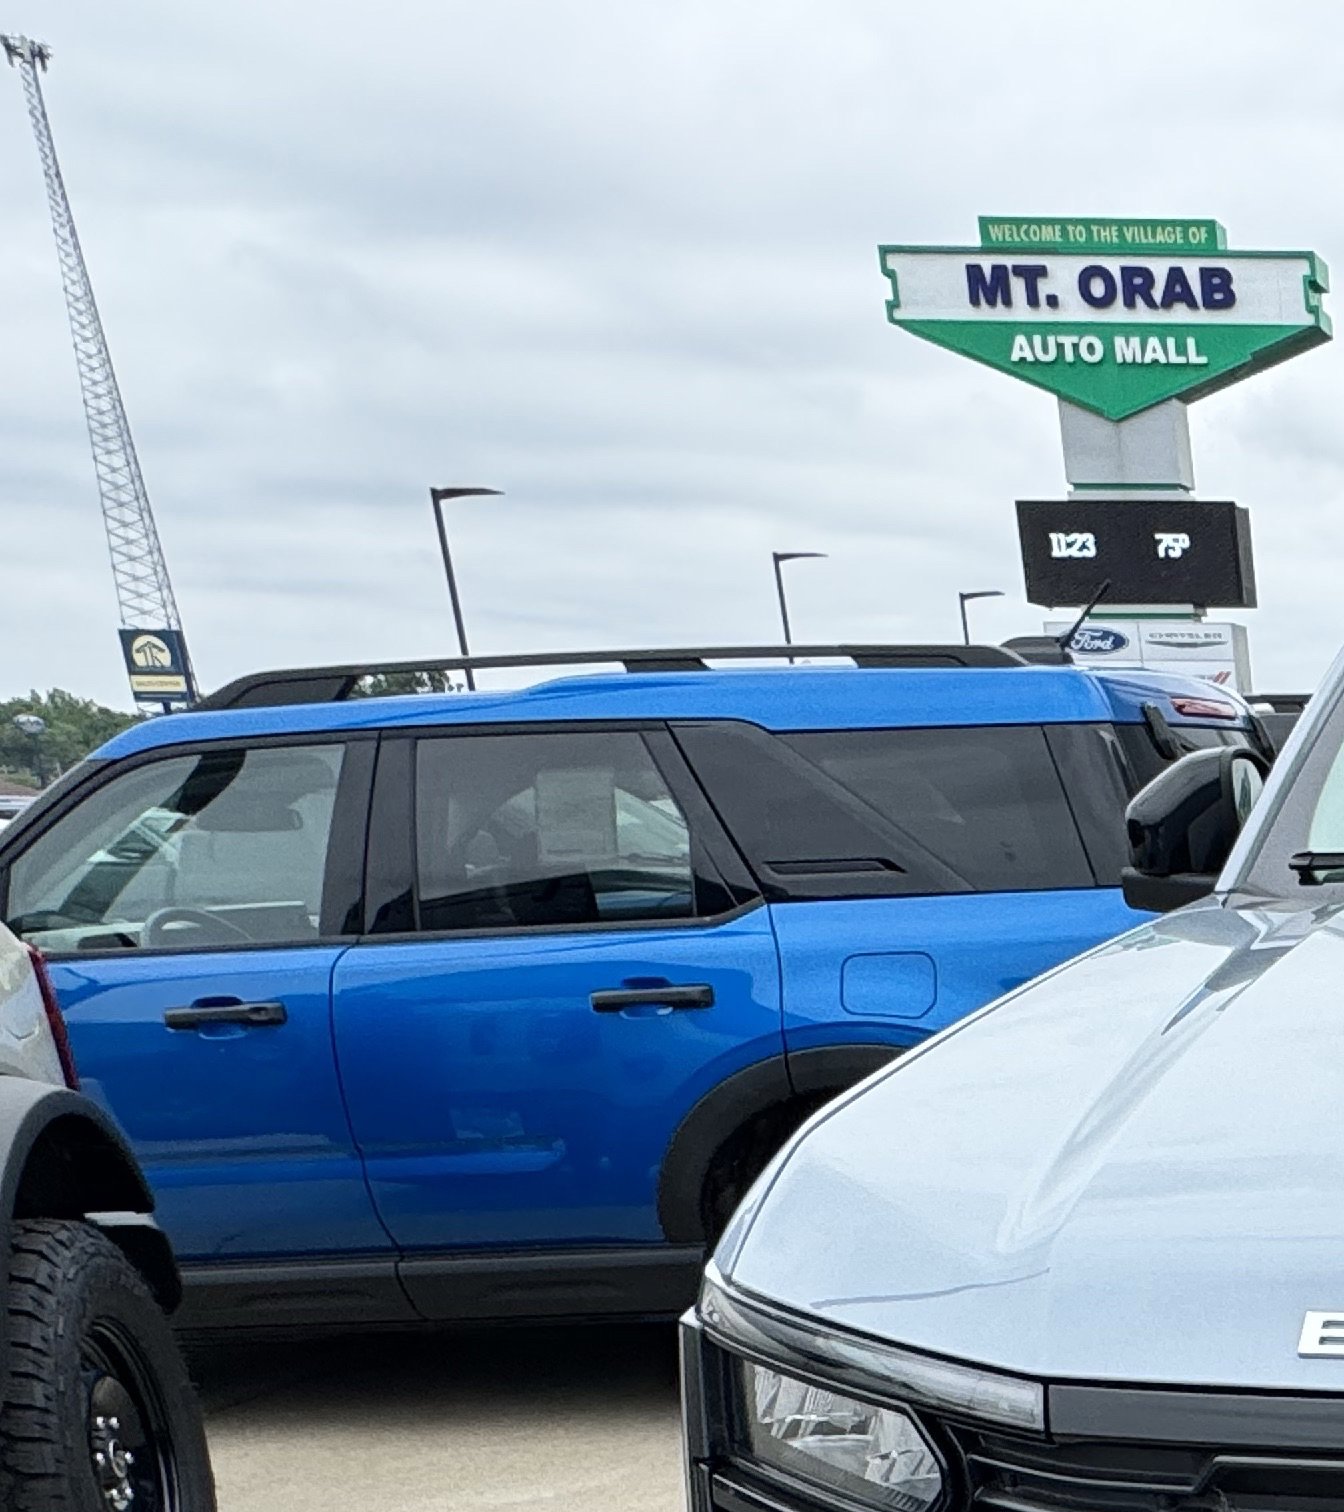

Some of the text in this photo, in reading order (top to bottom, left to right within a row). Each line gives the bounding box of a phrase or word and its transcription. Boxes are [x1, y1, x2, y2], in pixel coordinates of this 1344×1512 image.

[988, 224, 1208, 244] WELCOME TO THE VILLAGE OF
[965, 263, 1238, 310] MT. ORAB
[1010, 334, 1208, 364] AUTO MALL
[1070, 630, 1115, 650] Ford
